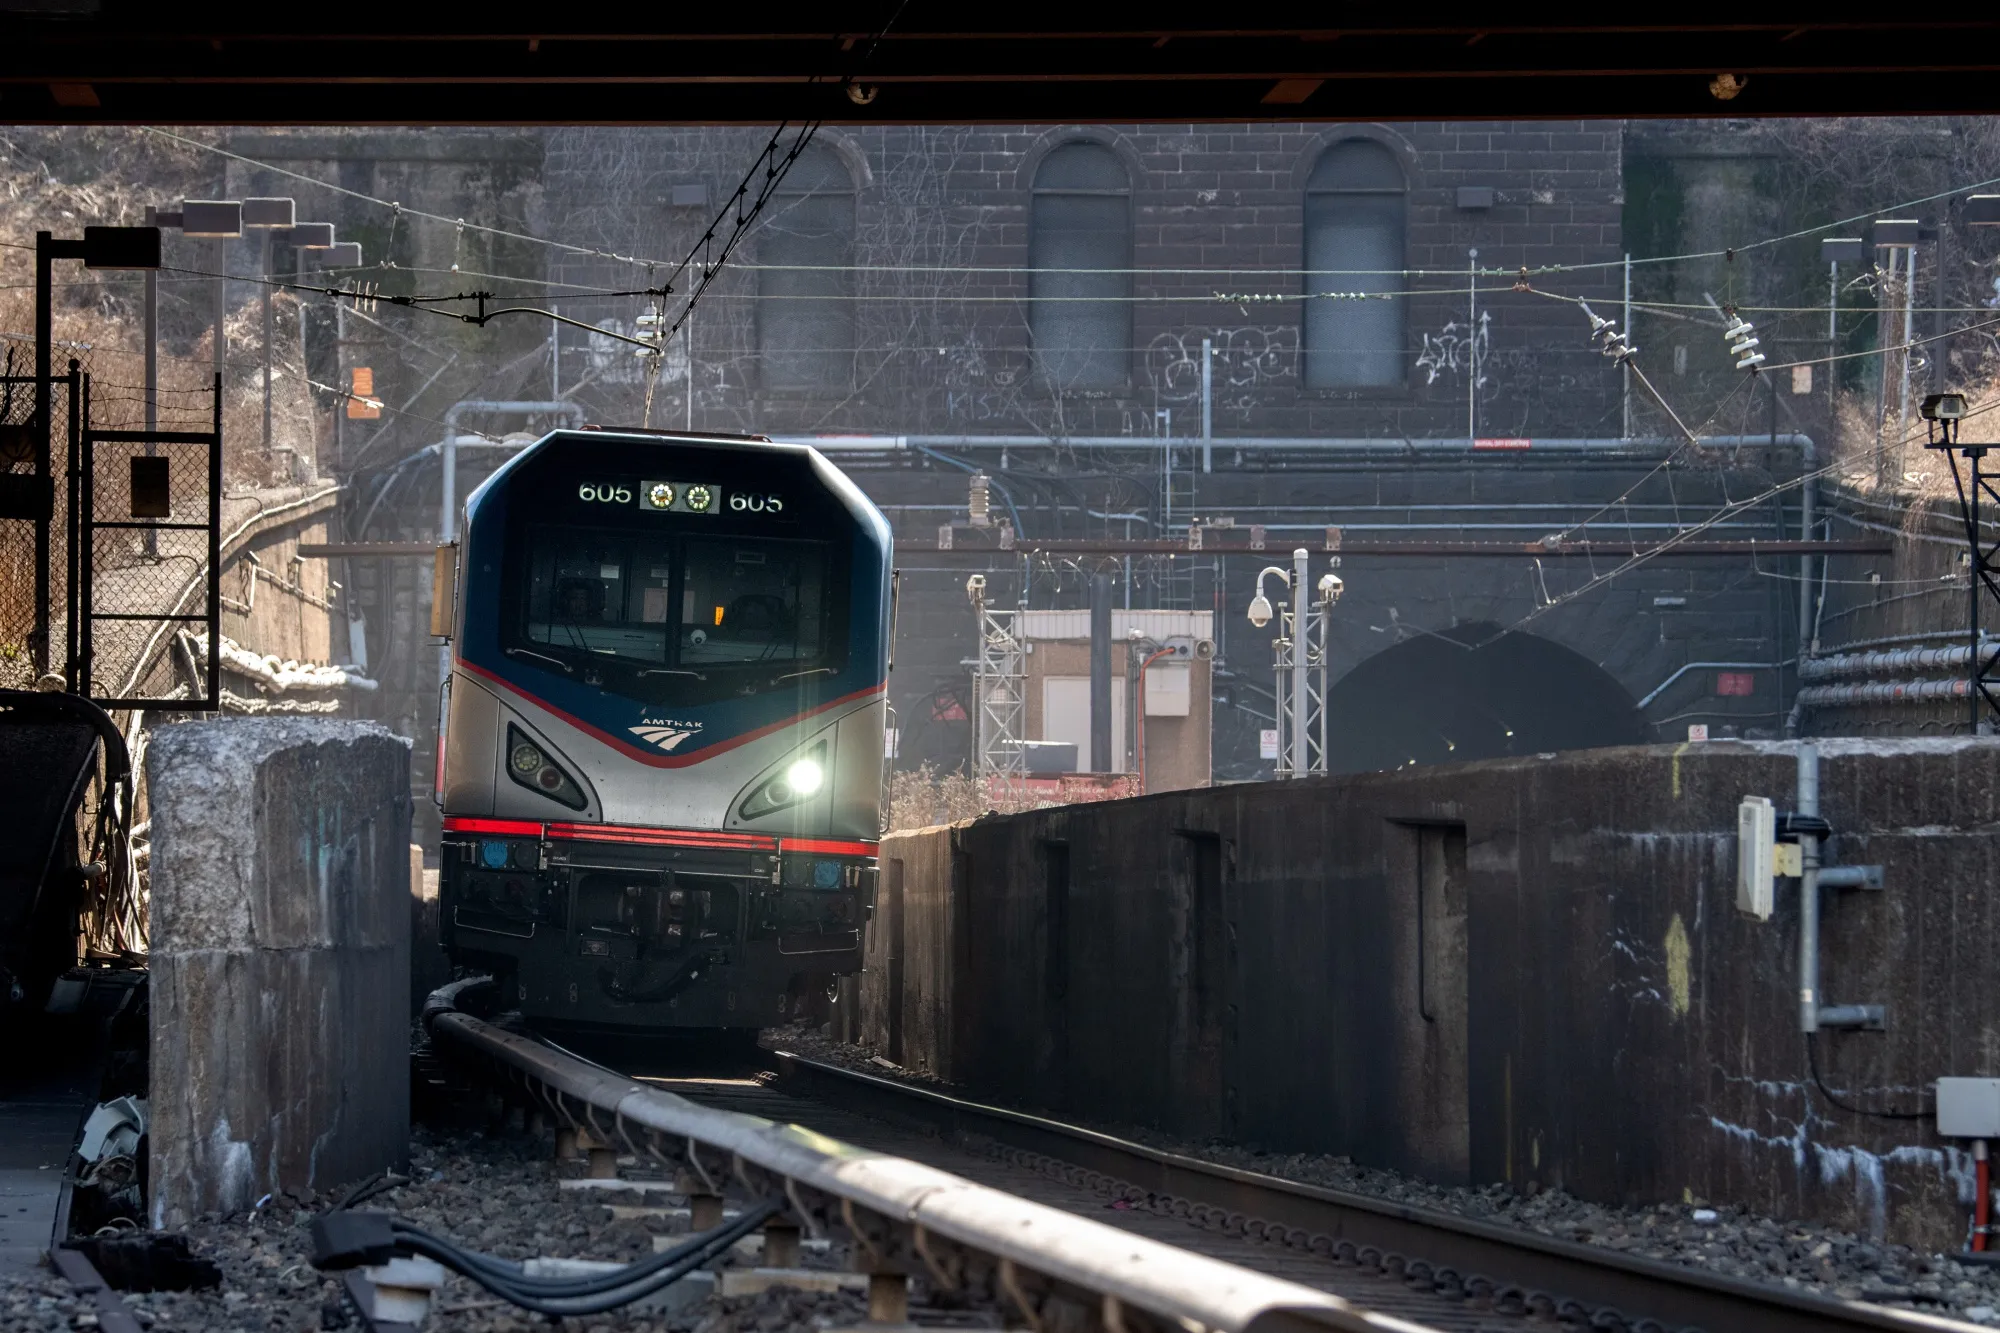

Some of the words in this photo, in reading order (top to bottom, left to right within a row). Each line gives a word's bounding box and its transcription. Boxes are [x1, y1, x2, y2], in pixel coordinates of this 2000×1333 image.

[578, 482, 632, 504] 605
[729, 492, 784, 513] 605
[642, 718, 703, 728] AMTRAK
